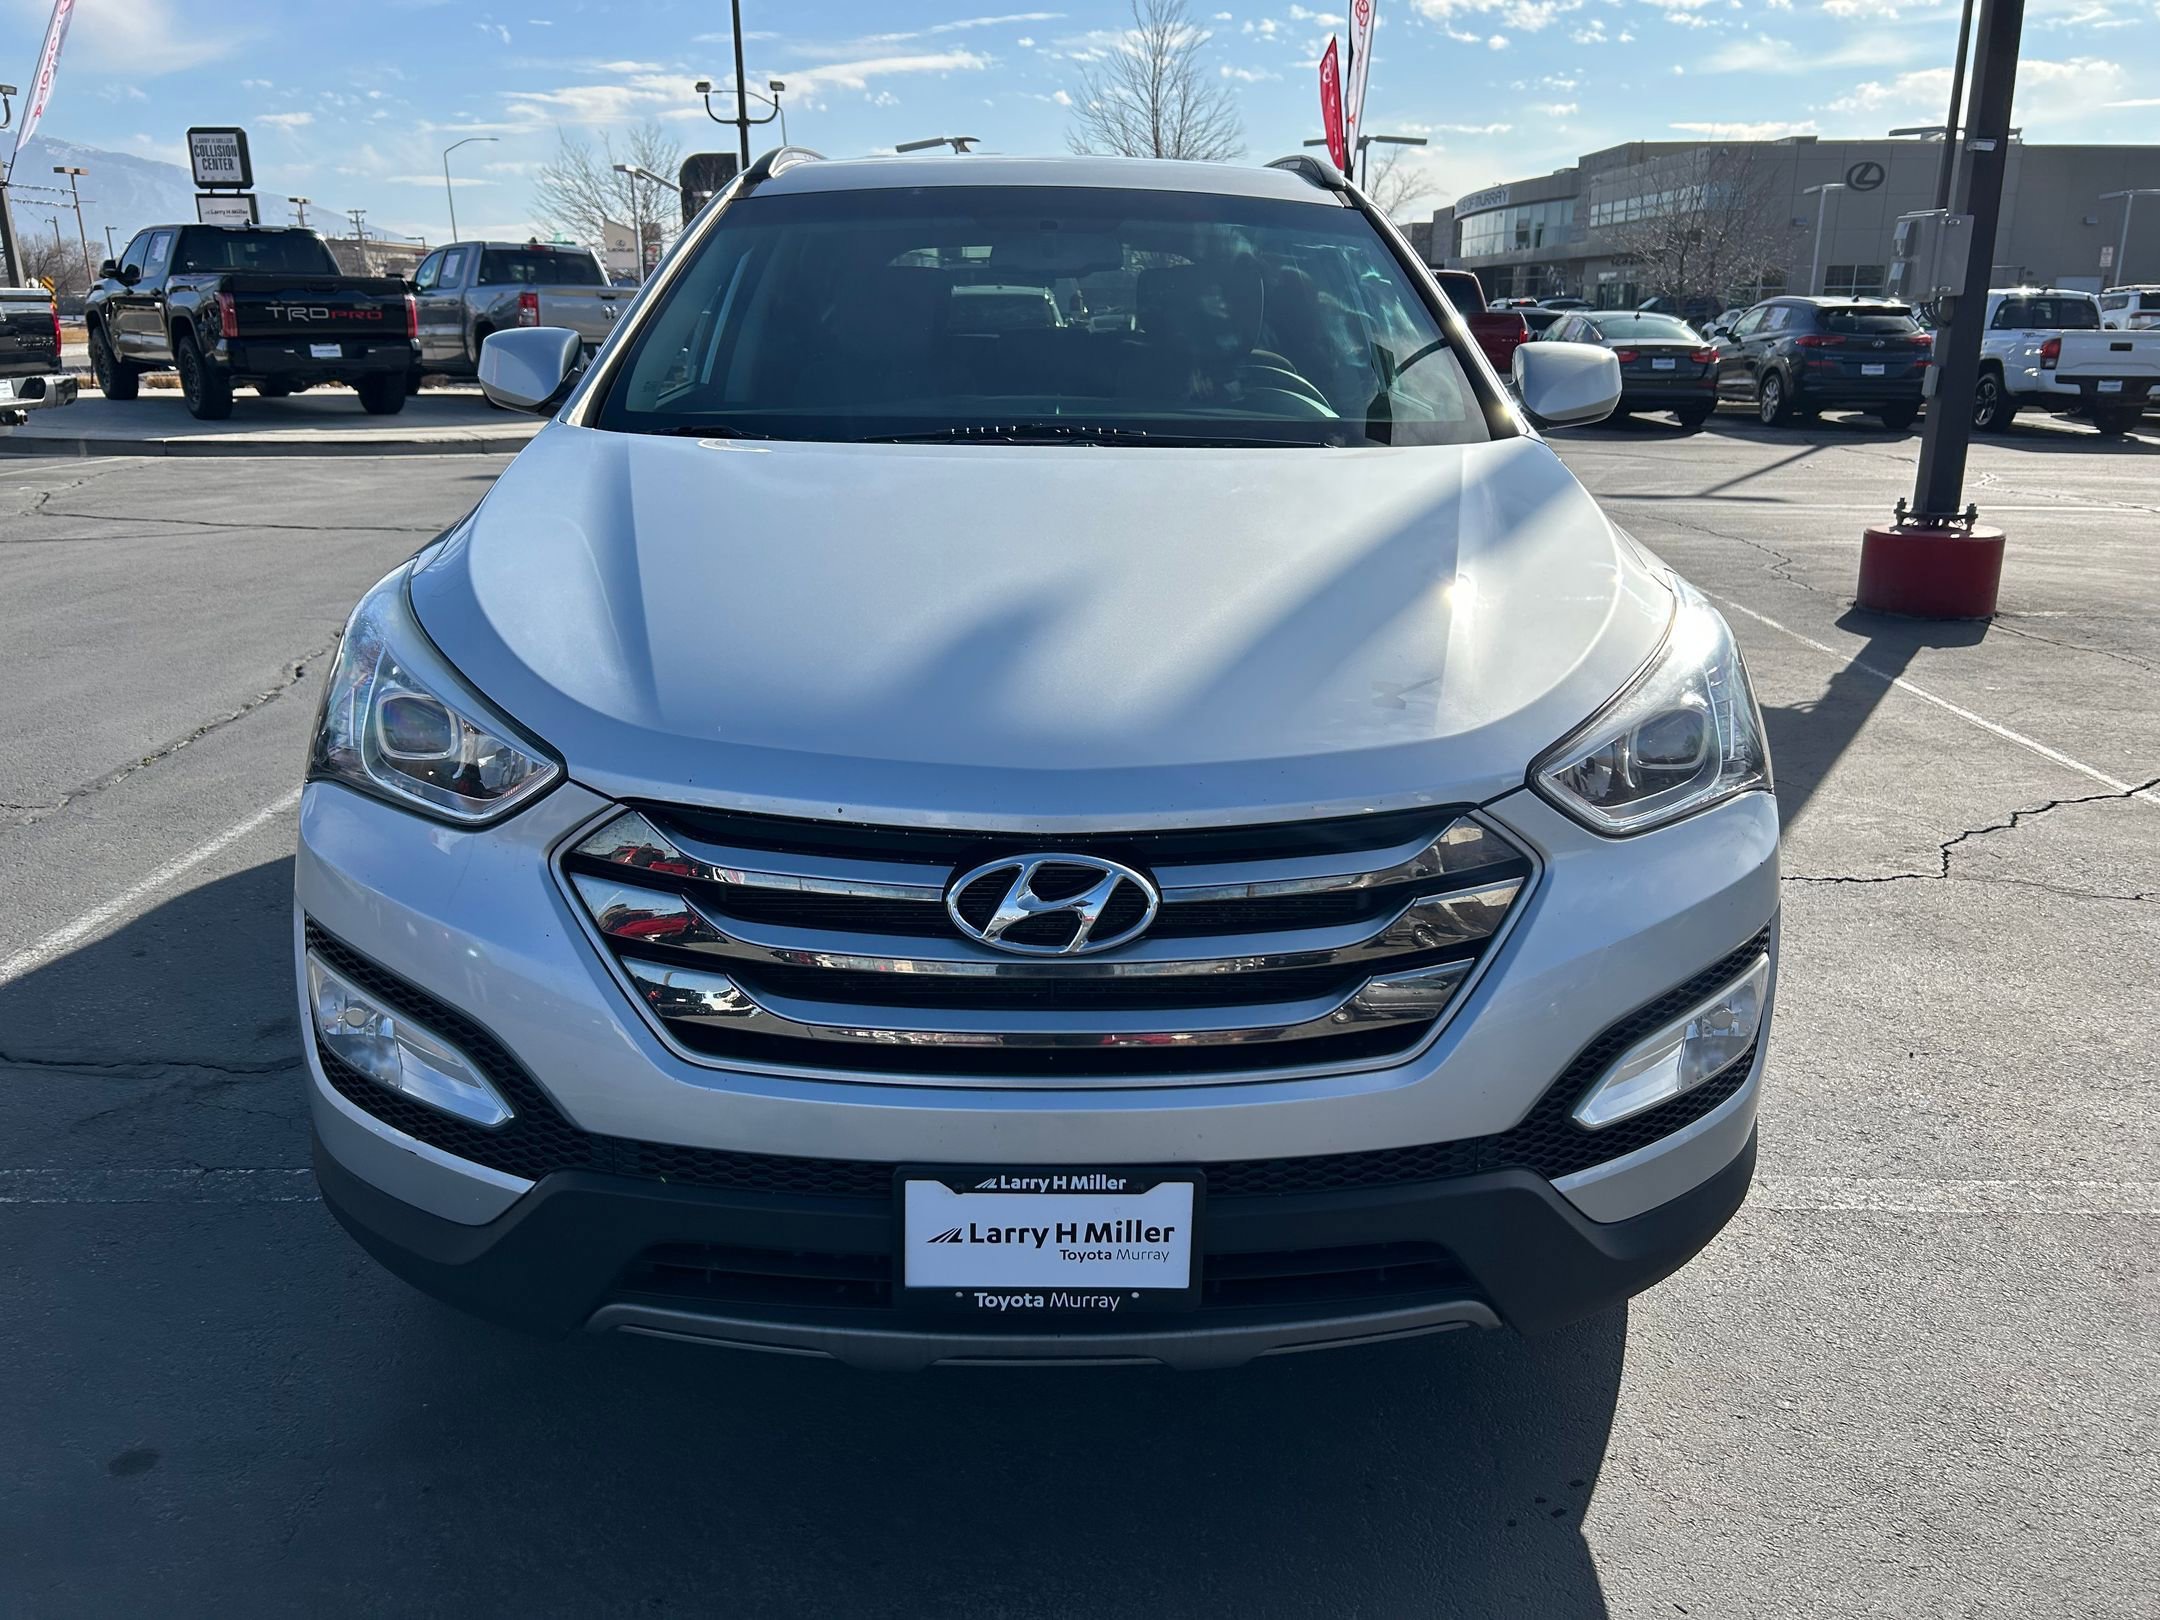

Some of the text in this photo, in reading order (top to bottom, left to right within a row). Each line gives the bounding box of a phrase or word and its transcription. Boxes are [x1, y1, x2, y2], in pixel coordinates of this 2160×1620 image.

[194, 145, 237, 157] COLLISION
[202, 158, 235, 171] CENTER
[1000, 1174, 1126, 1193] Larry H Miller
[969, 1220, 1175, 1249] Larry H Miller
[1059, 1249, 1170, 1263] Toyota Murray
[974, 1292, 1121, 1311] Toyota Murray
